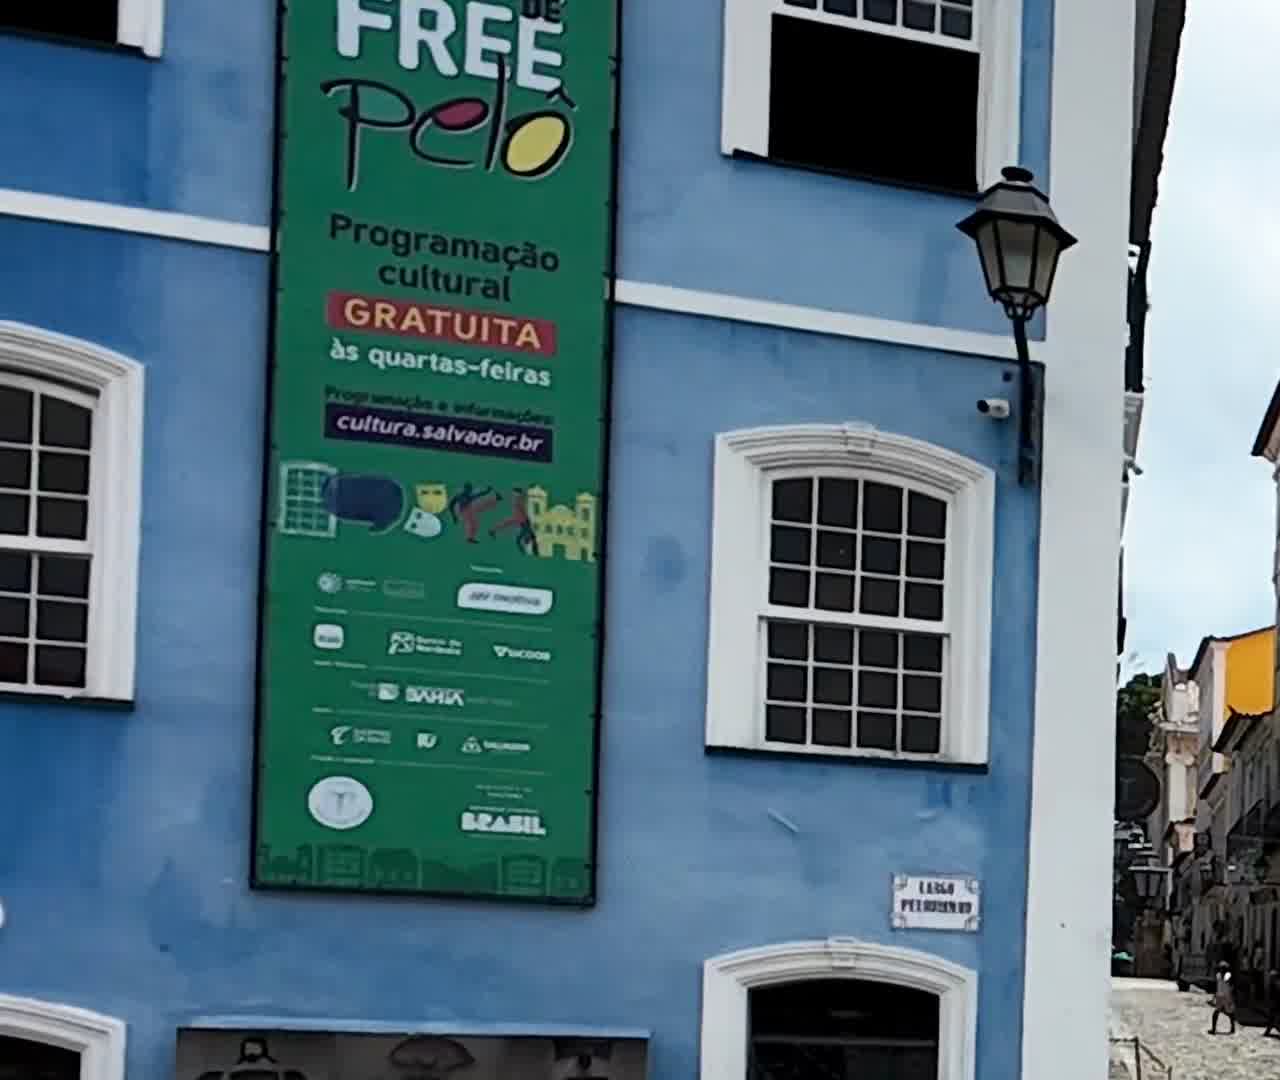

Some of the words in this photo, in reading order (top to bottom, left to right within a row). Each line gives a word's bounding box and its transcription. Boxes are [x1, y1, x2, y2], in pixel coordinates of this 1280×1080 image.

[336, 0, 564, 93] FREE
[330, 213, 560, 274] Programação
[377, 262, 512, 302] cultural
[343, 298, 542, 350] GRATUITA
[330, 339, 359, 362] às
[368, 347, 552, 387] quartas-feiras
[336, 413, 545, 453] cultura.salvador.br
[460, 811, 547, 835] BRASIL
